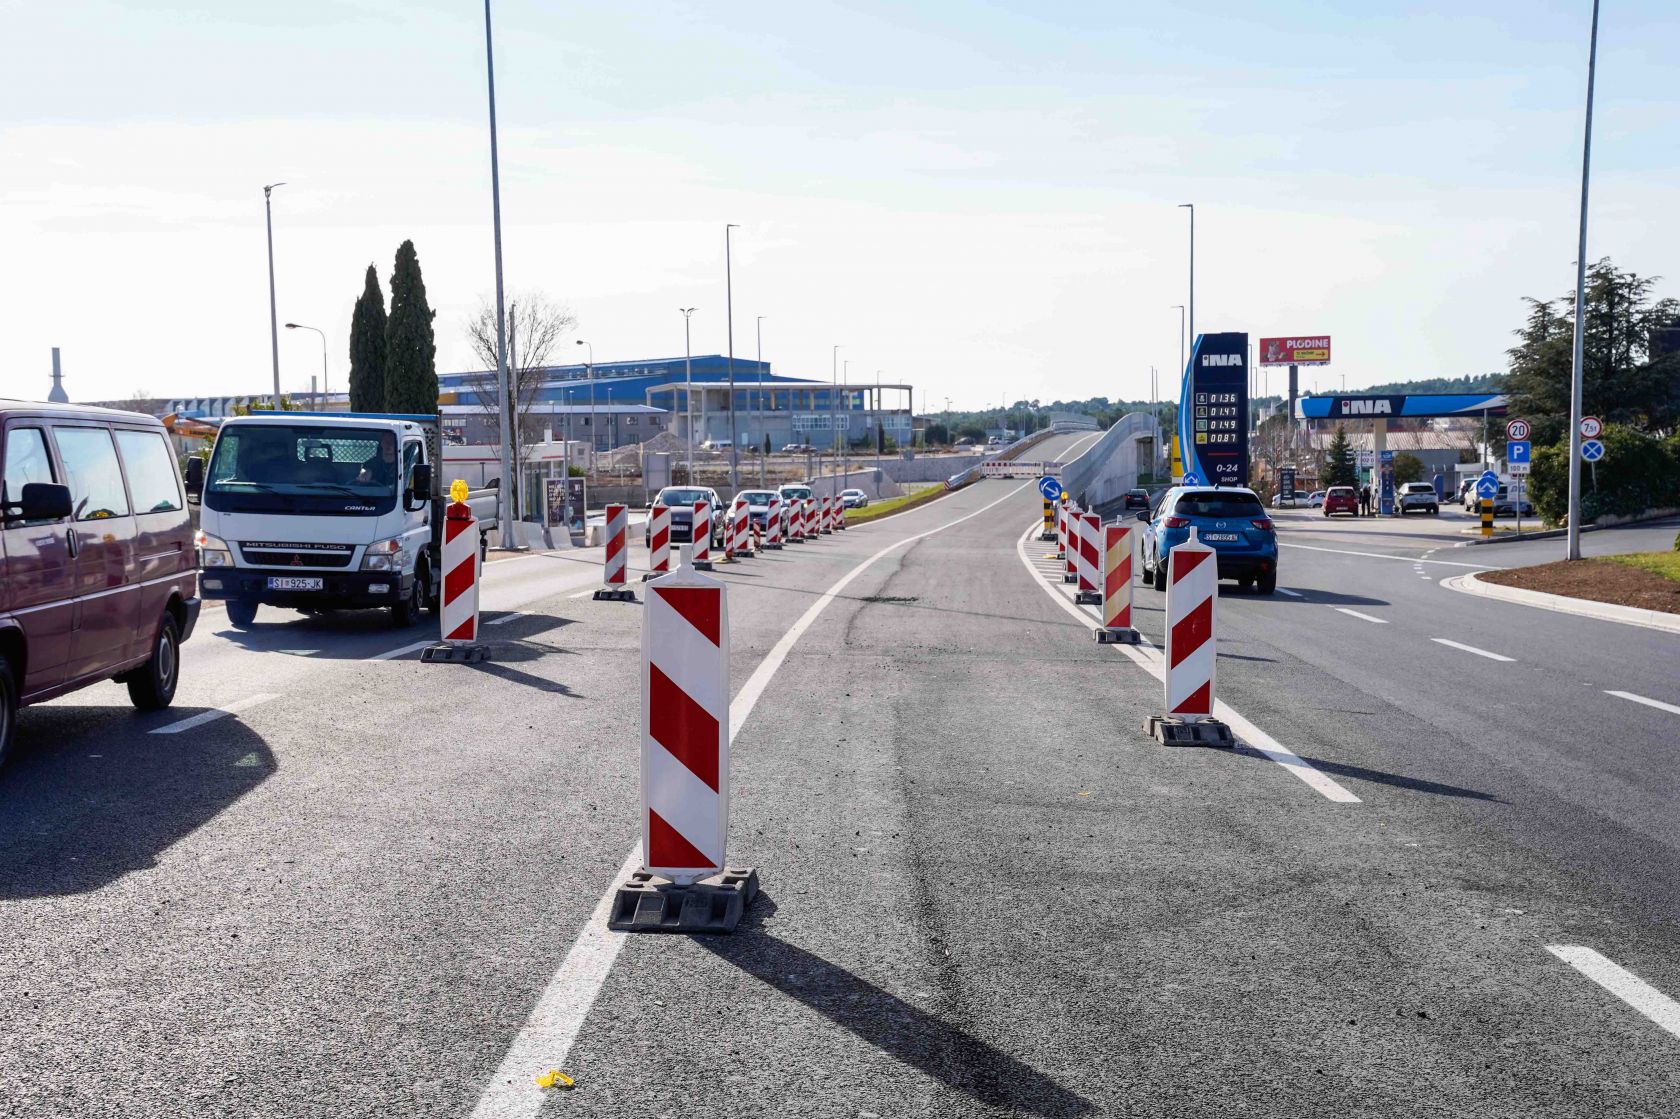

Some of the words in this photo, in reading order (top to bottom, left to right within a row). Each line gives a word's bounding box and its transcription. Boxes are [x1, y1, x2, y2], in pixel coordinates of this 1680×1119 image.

[1286, 338, 1329, 349] PLODINE
[1202, 354, 1243, 367] INA
[1210, 407, 1236, 416] 01.47
[1341, 399, 1392, 415] INA
[1210, 420, 1236, 430] 01.49
[1511, 425, 1525, 436] 20
[1210, 433, 1236, 443] 00.87
[1513, 445, 1524, 459] P
[1216, 464, 1239, 472] 0-24
[246, 541, 311, 549] MITSUBISHI
